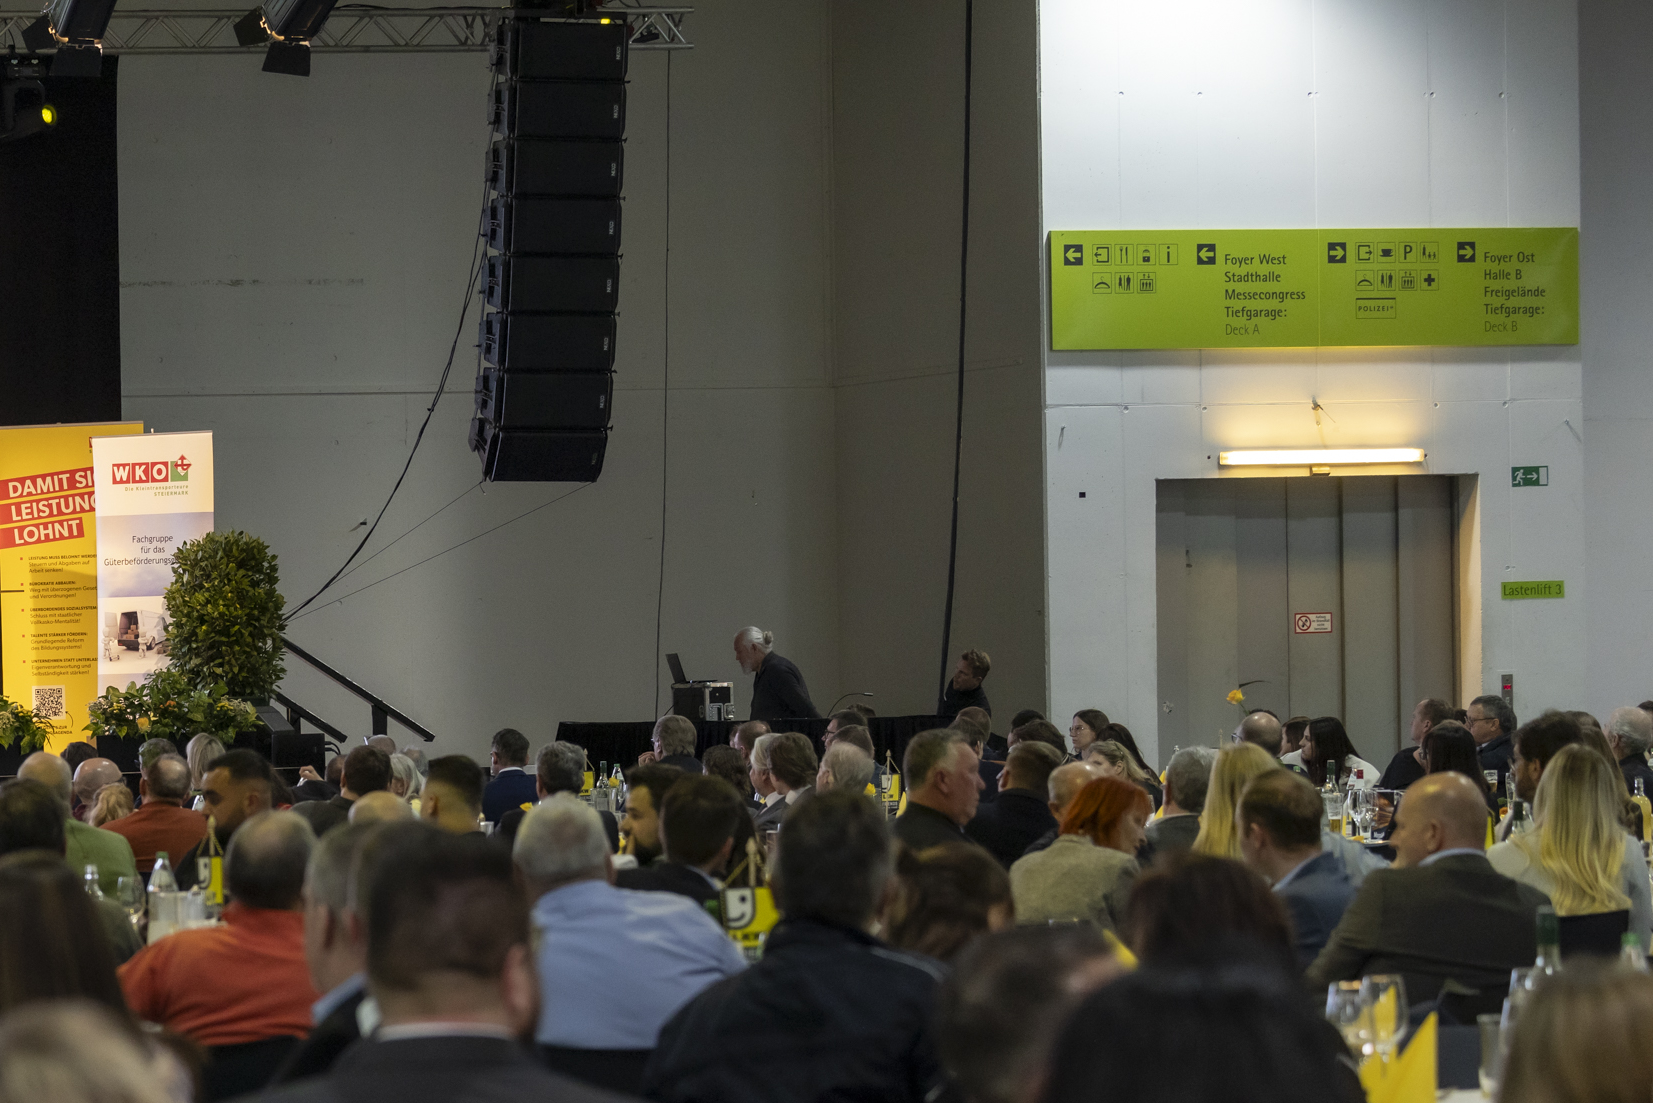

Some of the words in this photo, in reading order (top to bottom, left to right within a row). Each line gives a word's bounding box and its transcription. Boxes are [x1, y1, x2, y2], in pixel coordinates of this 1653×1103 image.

[1224, 254, 1254, 268] Foyer
[1258, 254, 1287, 265] West
[1484, 252, 1513, 266] Foyer
[1516, 251, 1536, 263] Ost
[1224, 271, 1281, 283] Stadthalle
[1484, 269, 1512, 280] Halle
[1515, 269, 1523, 280] B
[1224, 289, 1306, 303] Messecongress
[1484, 286, 1546, 300] Freigelände
[1224, 306, 1288, 320] Tiefgarage:
[1484, 304, 1545, 318] Tiefgarage:
[1225, 324, 1250, 335] Deck
[1252, 324, 1260, 335] A
[1484, 321, 1509, 333] Deck
[1511, 321, 1518, 332] B
[113, 463, 167, 482] WKO
[8, 473, 70, 498] DAMIT
[75, 470, 95, 487] SI
[13, 520, 80, 544] LOHNT
[132, 535, 173, 544] Fachgruppe
[1503, 584, 1552, 597] Lastenlift
[1555, 583, 1562, 595] 3
